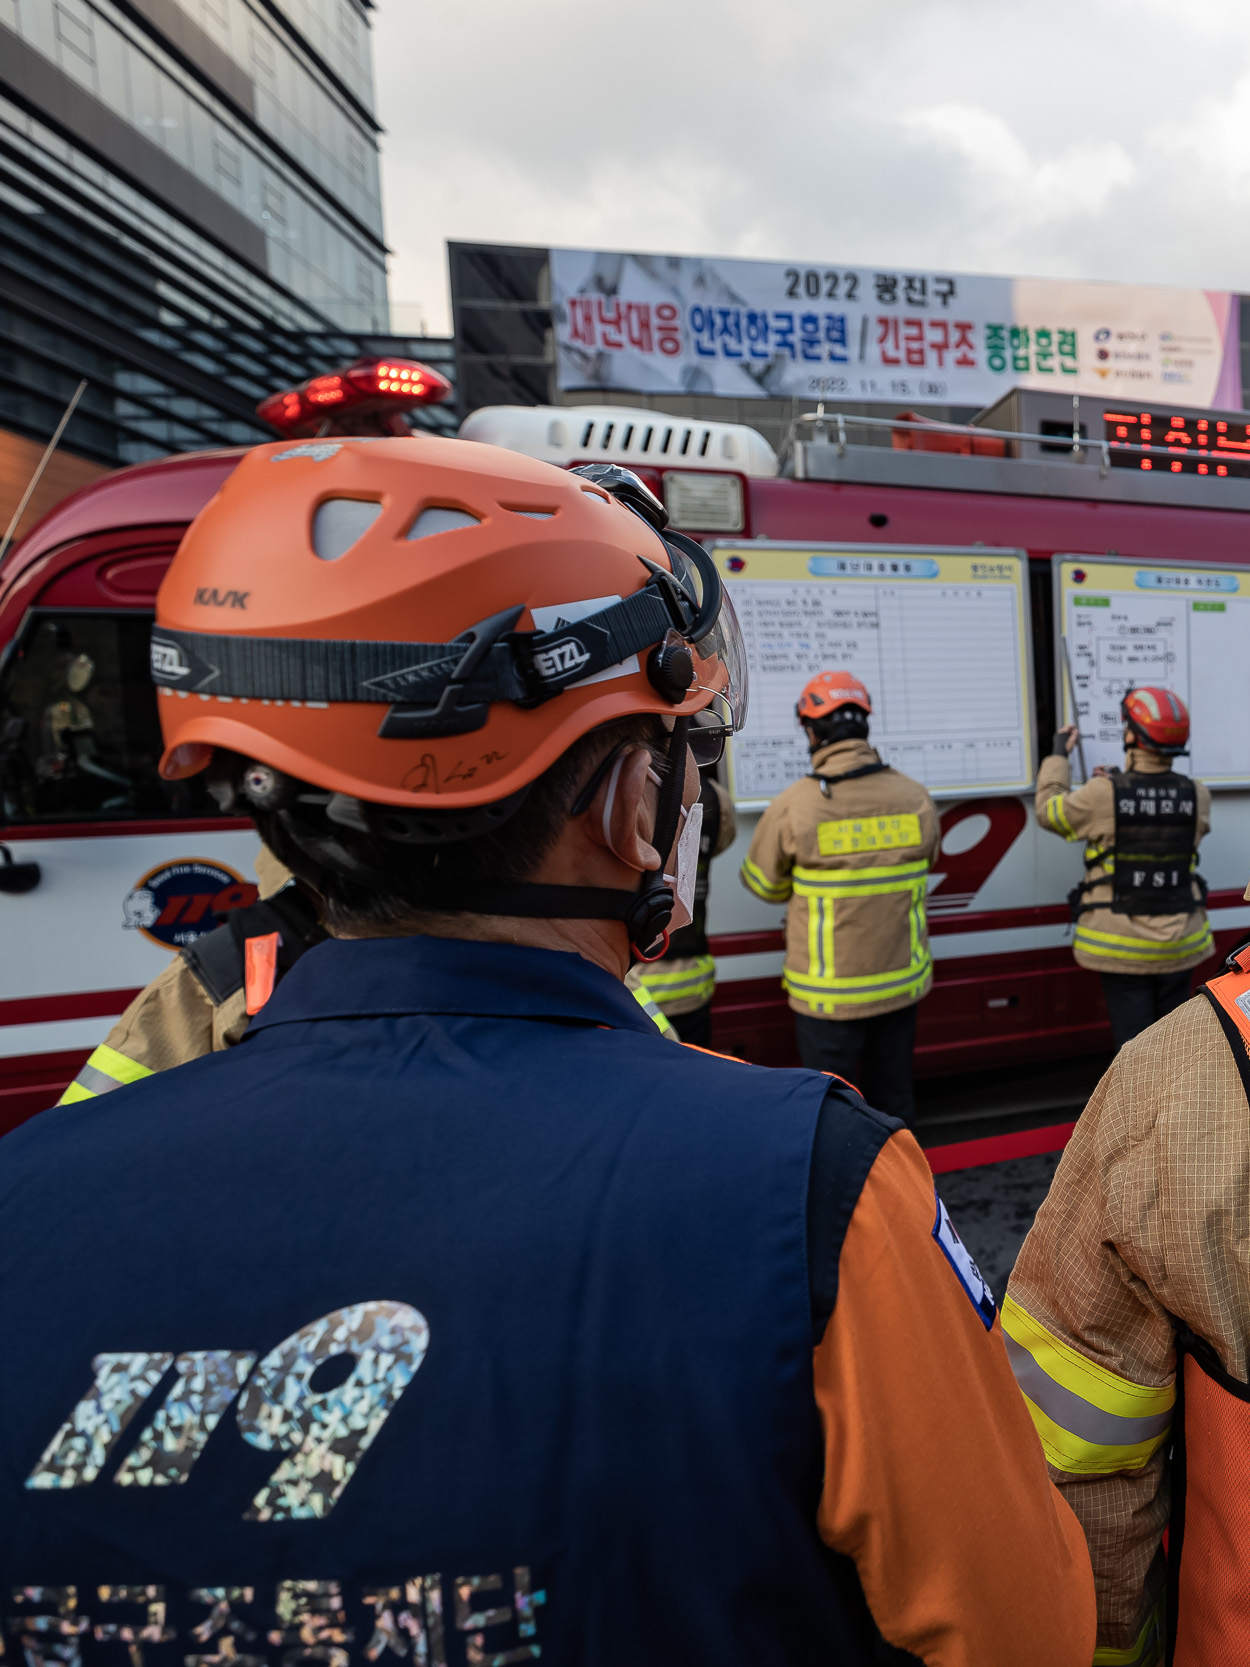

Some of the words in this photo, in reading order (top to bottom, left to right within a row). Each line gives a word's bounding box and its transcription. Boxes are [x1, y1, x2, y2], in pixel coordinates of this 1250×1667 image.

[785, 268, 860, 301] 2022
[874, 273, 957, 310] 광진구
[569, 297, 682, 357] 재난대응
[689, 304, 851, 364] 안전한국훈련
[877, 316, 976, 368] 긴급구조
[984, 322, 1080, 375] 종합훈련
[193, 586, 251, 611] KASK
[151, 643, 190, 675] ETZL
[24, 1299, 430, 1522] 119
[0, 1566, 547, 1667] 급구조통제단
